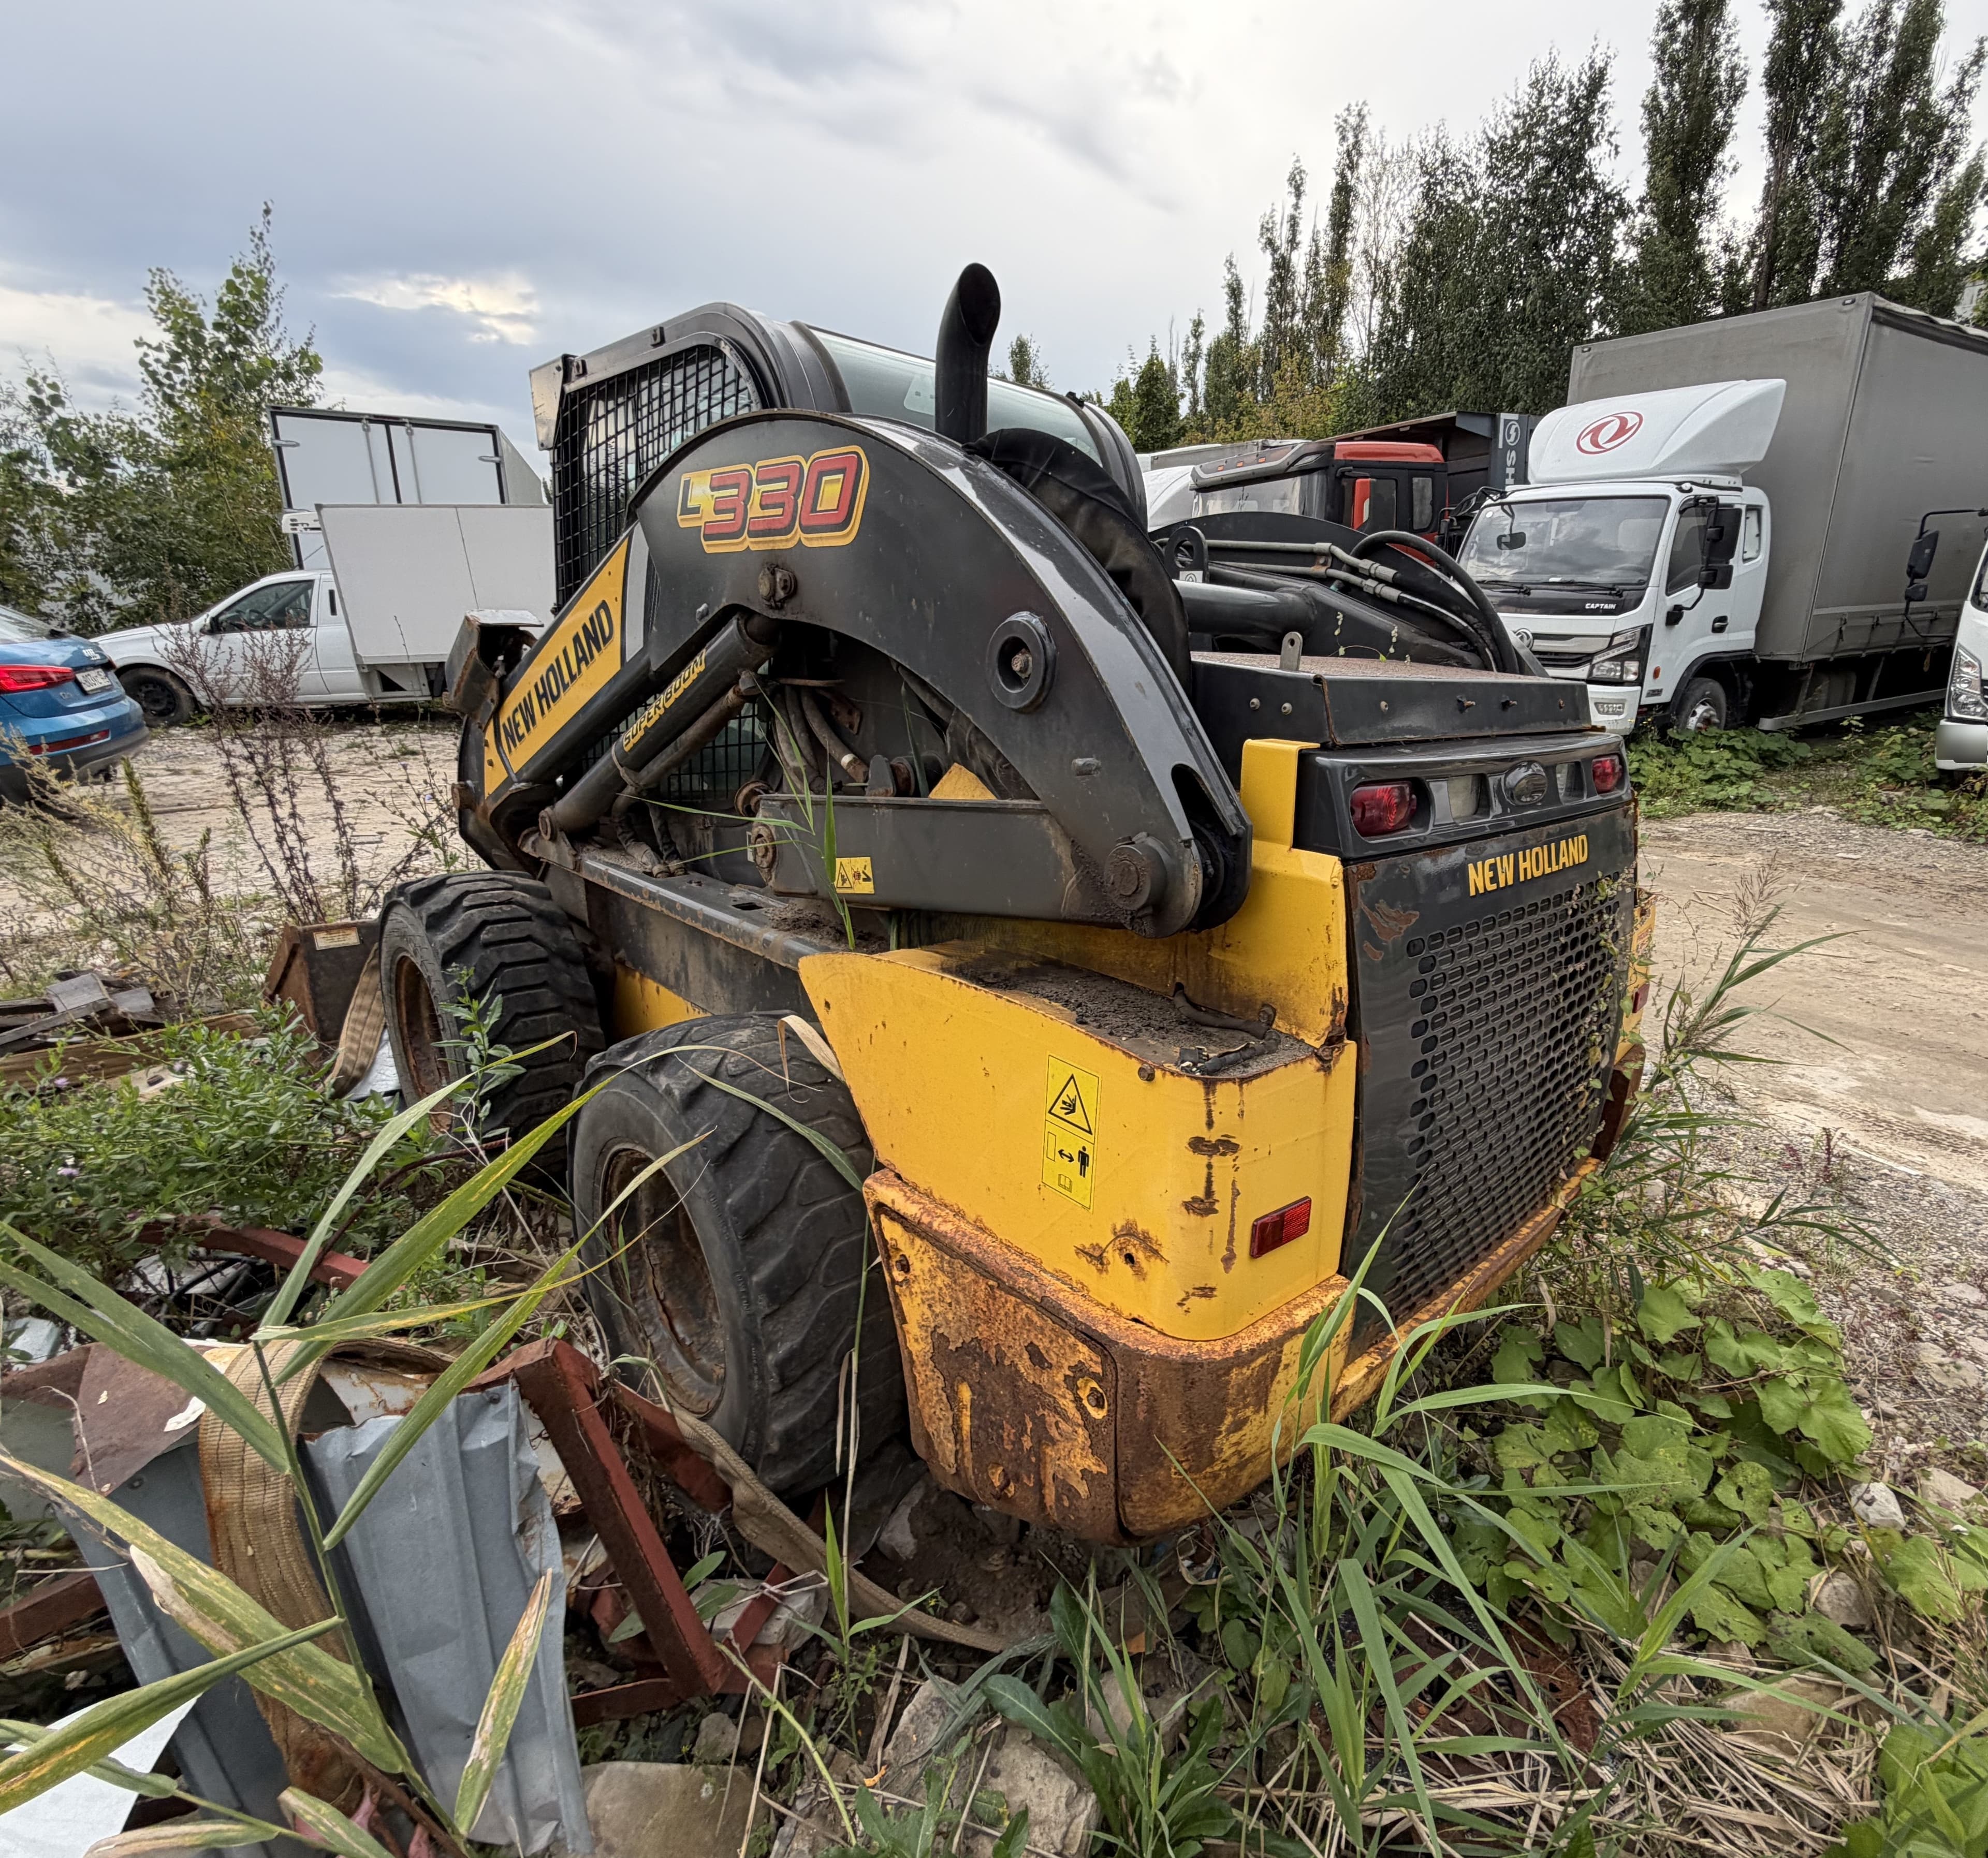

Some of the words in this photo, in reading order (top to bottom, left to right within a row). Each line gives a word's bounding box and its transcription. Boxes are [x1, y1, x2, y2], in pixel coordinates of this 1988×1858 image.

[677, 446, 869, 552] L330
[1505, 449, 1516, 484] SH
[502, 687, 538, 754] NEW
[534, 599, 615, 718] HOLLAND
[1468, 853, 1514, 896] NEW
[1518, 835, 1588, 882] HOLLAND
